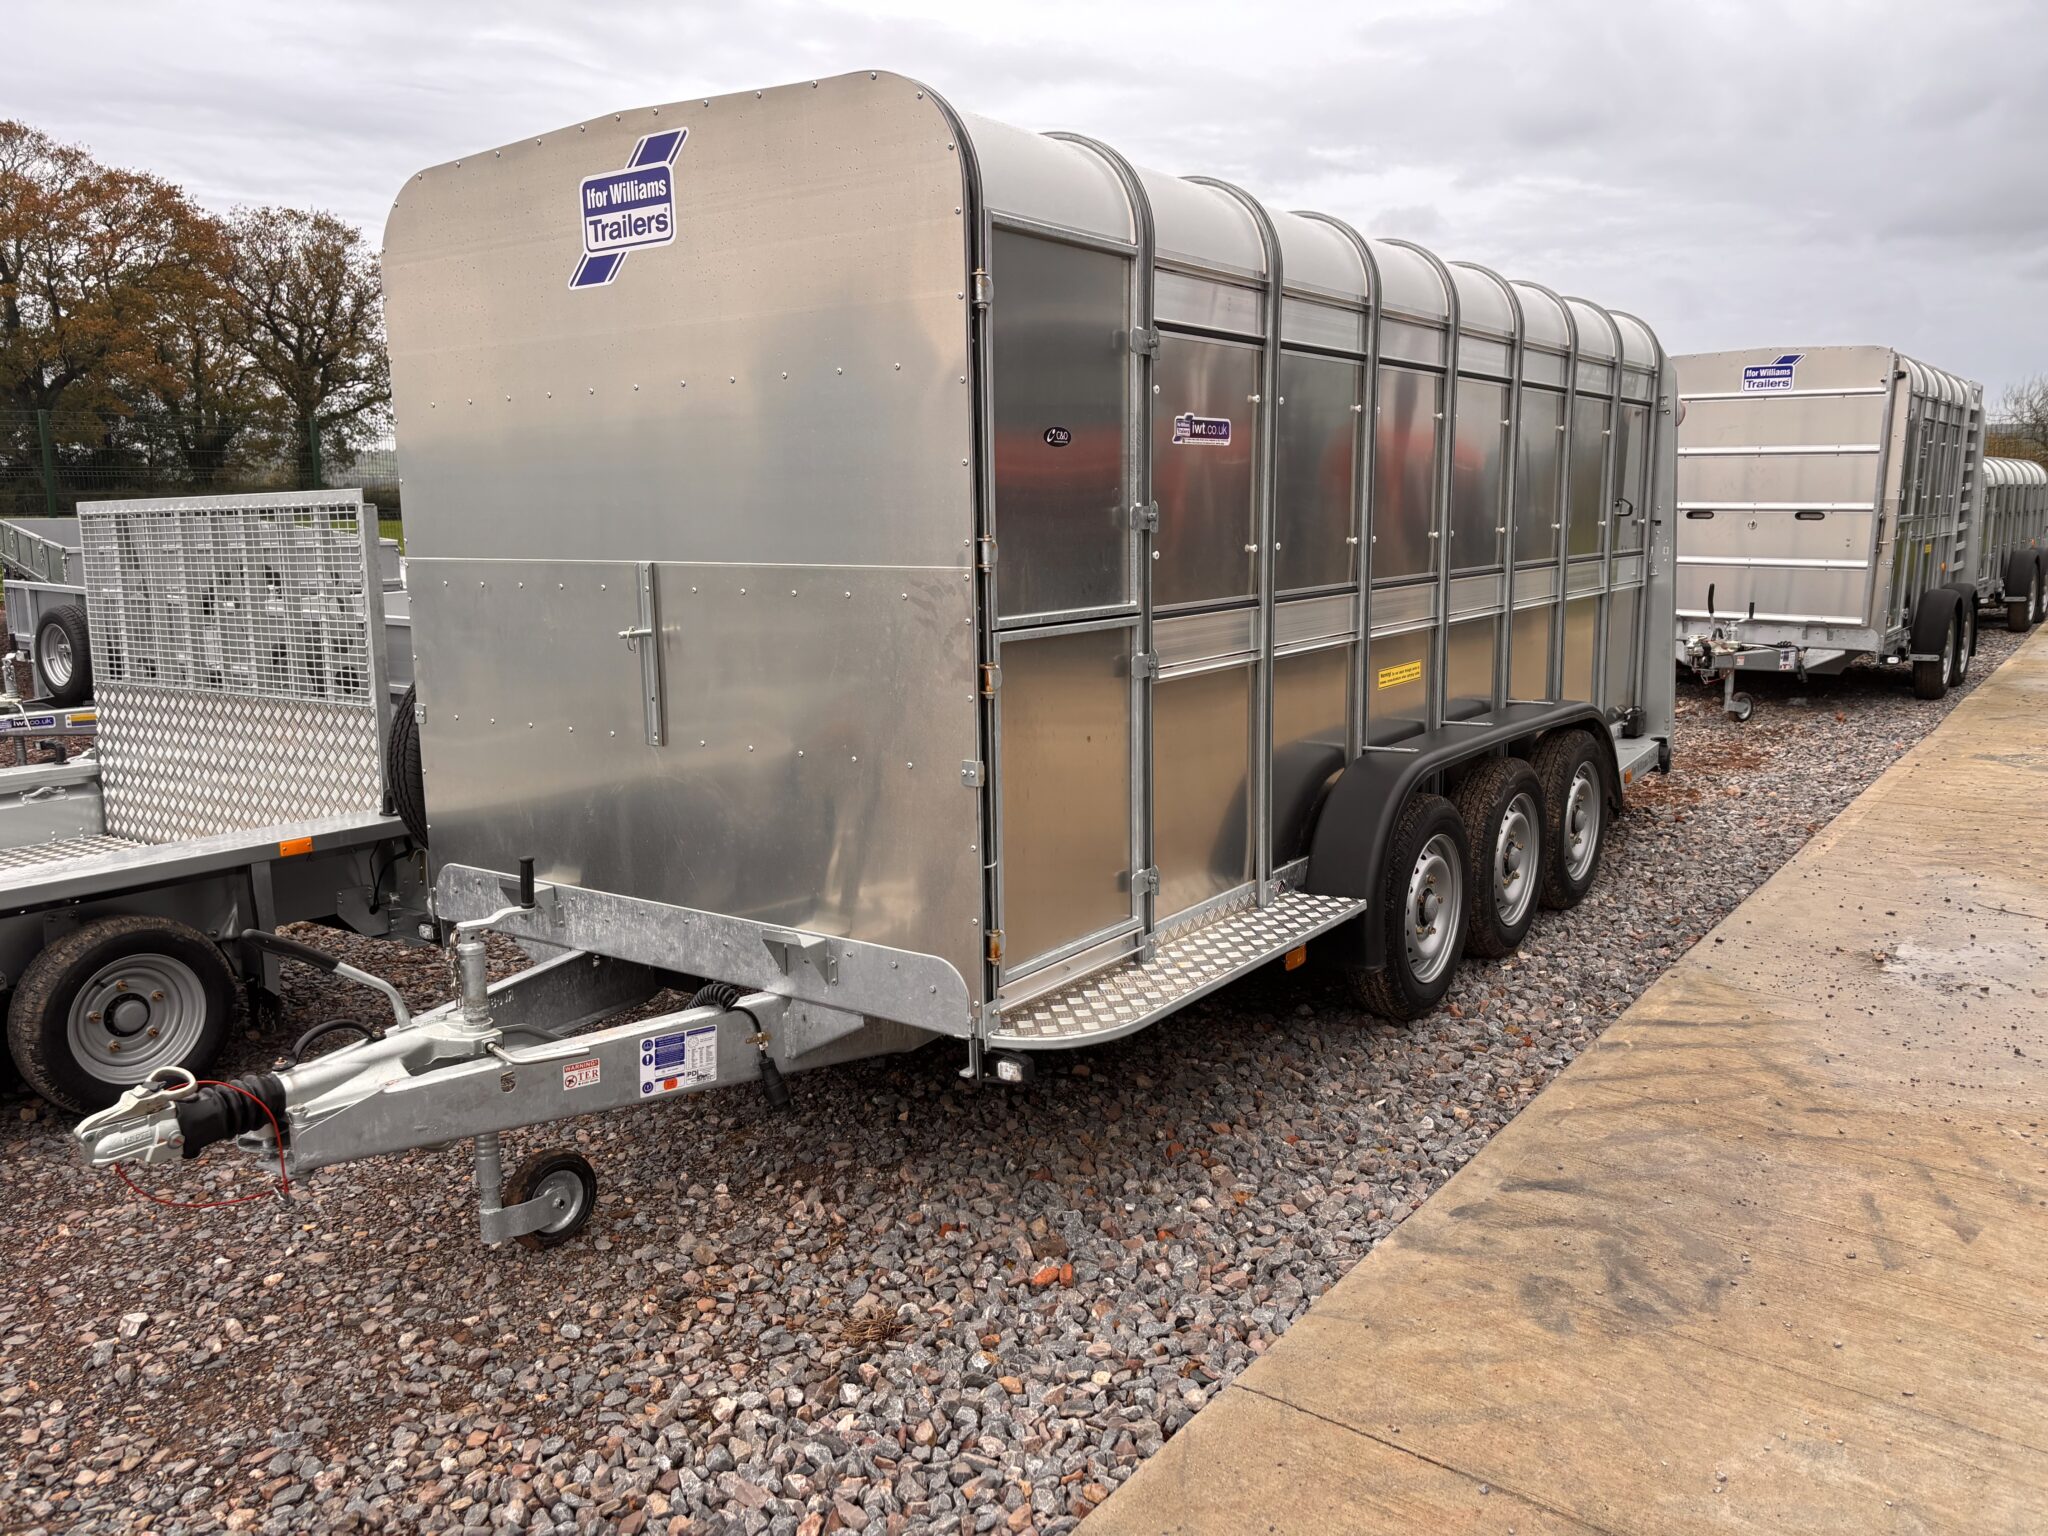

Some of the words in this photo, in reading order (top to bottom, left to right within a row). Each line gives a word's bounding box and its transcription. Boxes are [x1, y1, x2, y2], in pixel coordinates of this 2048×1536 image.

[586, 188, 608, 210] Ifor
[609, 179, 667, 205] Williams
[588, 212, 669, 243] Trailers
[1760, 368, 1791, 377] Williams
[1746, 379, 1790, 389] Trailers
[1191, 422, 1228, 435] iwt.co.uk
[13, 718, 52, 727] iwtco.uk
